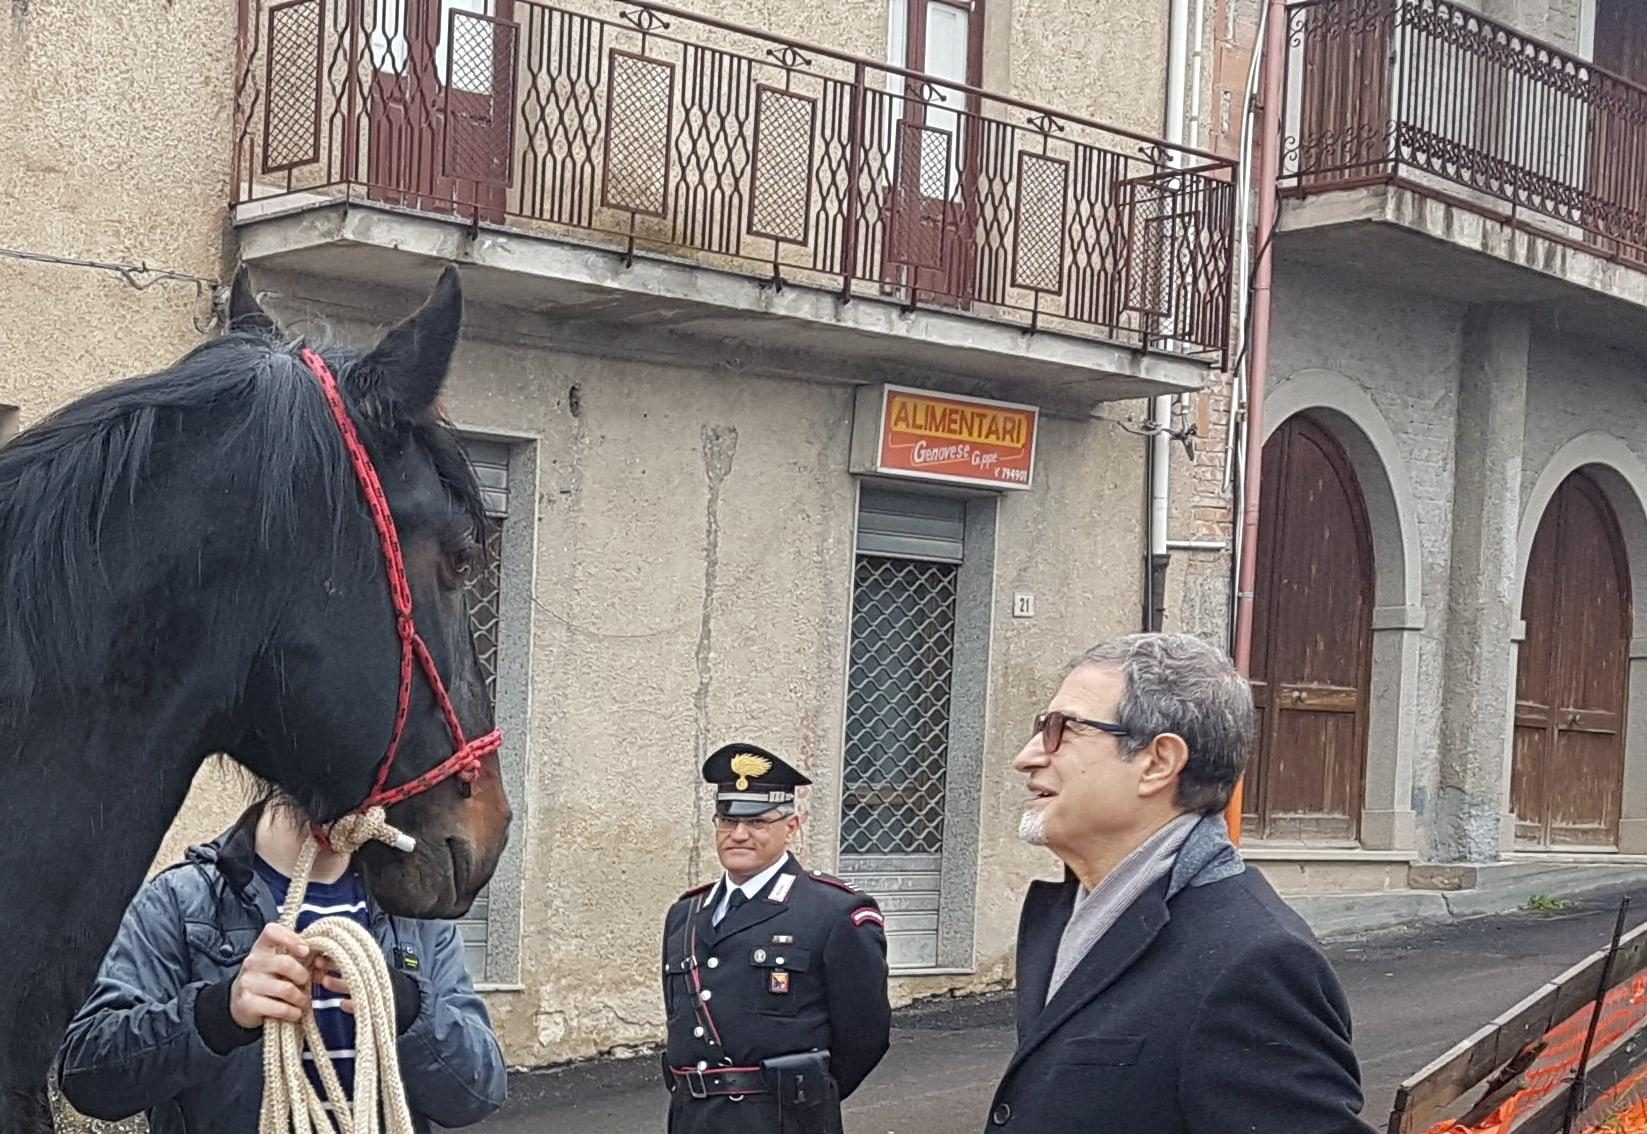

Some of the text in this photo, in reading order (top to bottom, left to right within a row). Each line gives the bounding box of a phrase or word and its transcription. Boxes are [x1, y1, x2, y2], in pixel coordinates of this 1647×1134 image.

[893, 401, 1022, 444] ALIMENTARI
[913, 440, 970, 463] Genovese
[1019, 597, 1029, 613] 21
